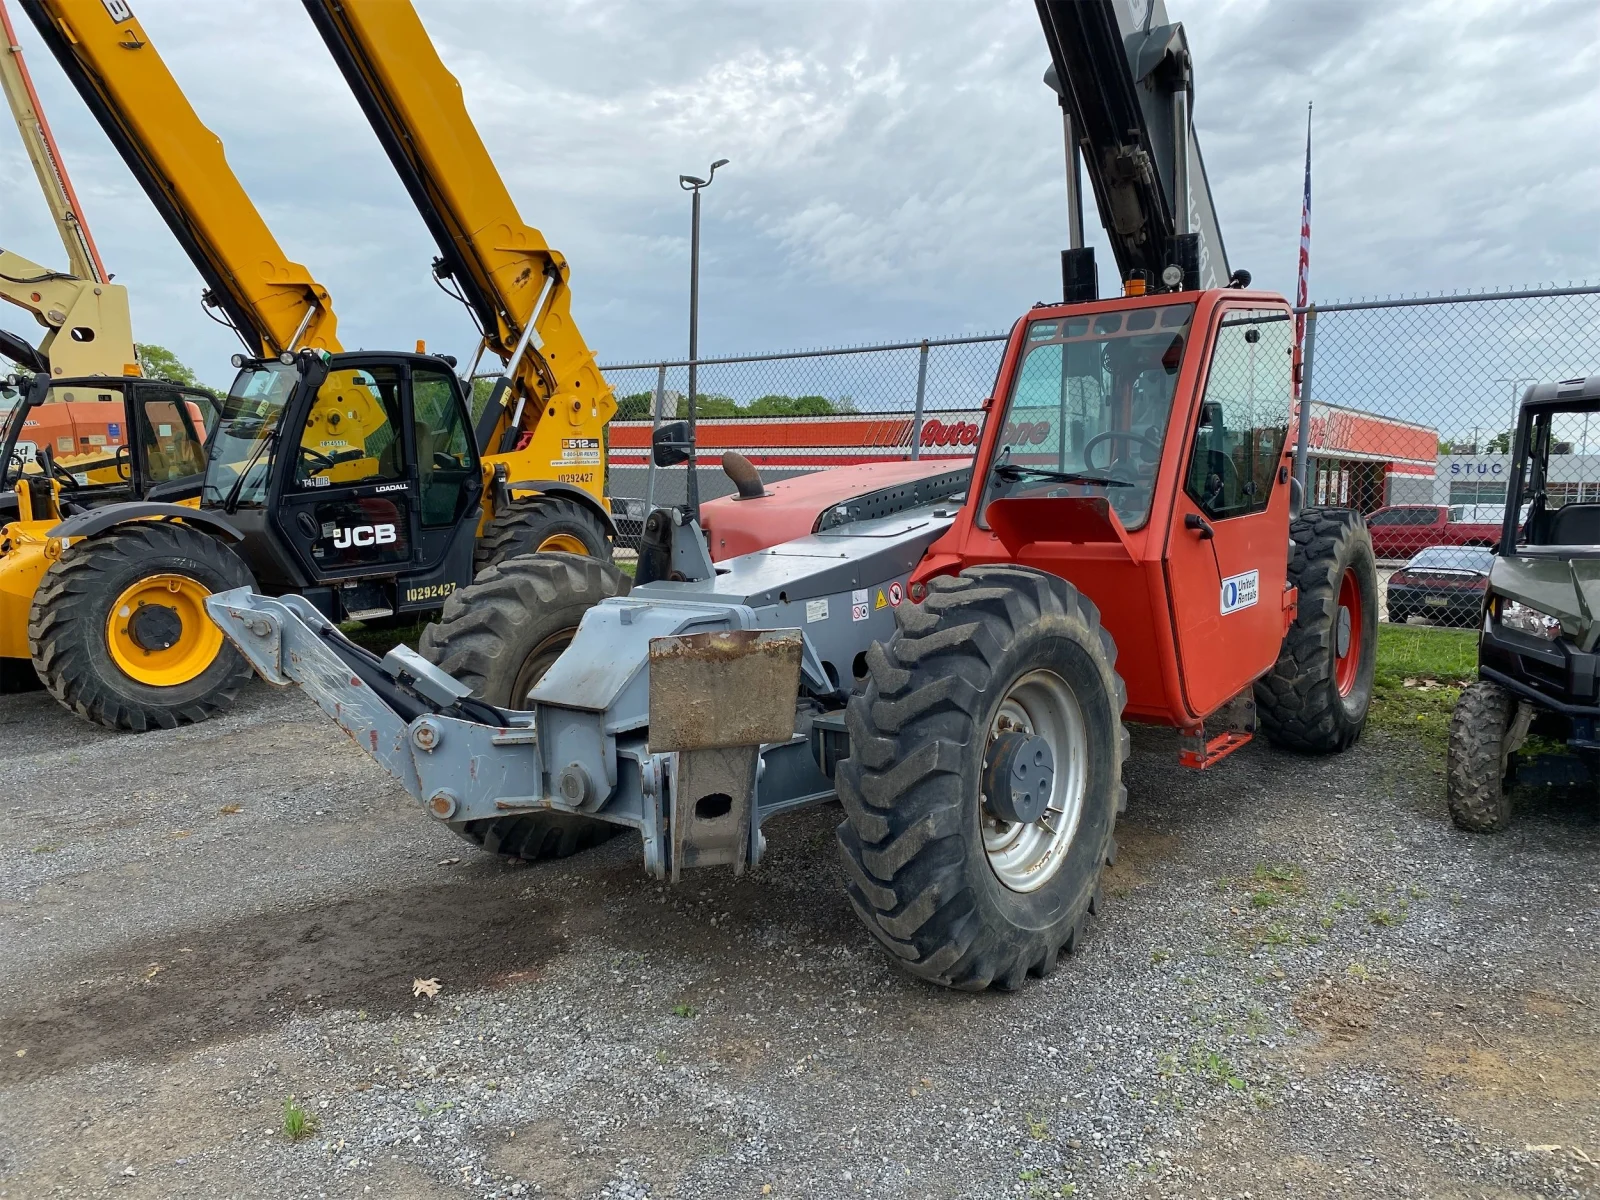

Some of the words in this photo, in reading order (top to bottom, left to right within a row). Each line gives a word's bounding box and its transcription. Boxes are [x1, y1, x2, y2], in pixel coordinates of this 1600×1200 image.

[920, 419, 1050, 447] Autoone
[375, 483, 409, 493] LOADALL
[333, 523, 397, 549] JCB
[406, 582, 457, 602] 10292427
[1238, 576, 1256, 592] United
[1238, 588, 1257, 604] Rentals
